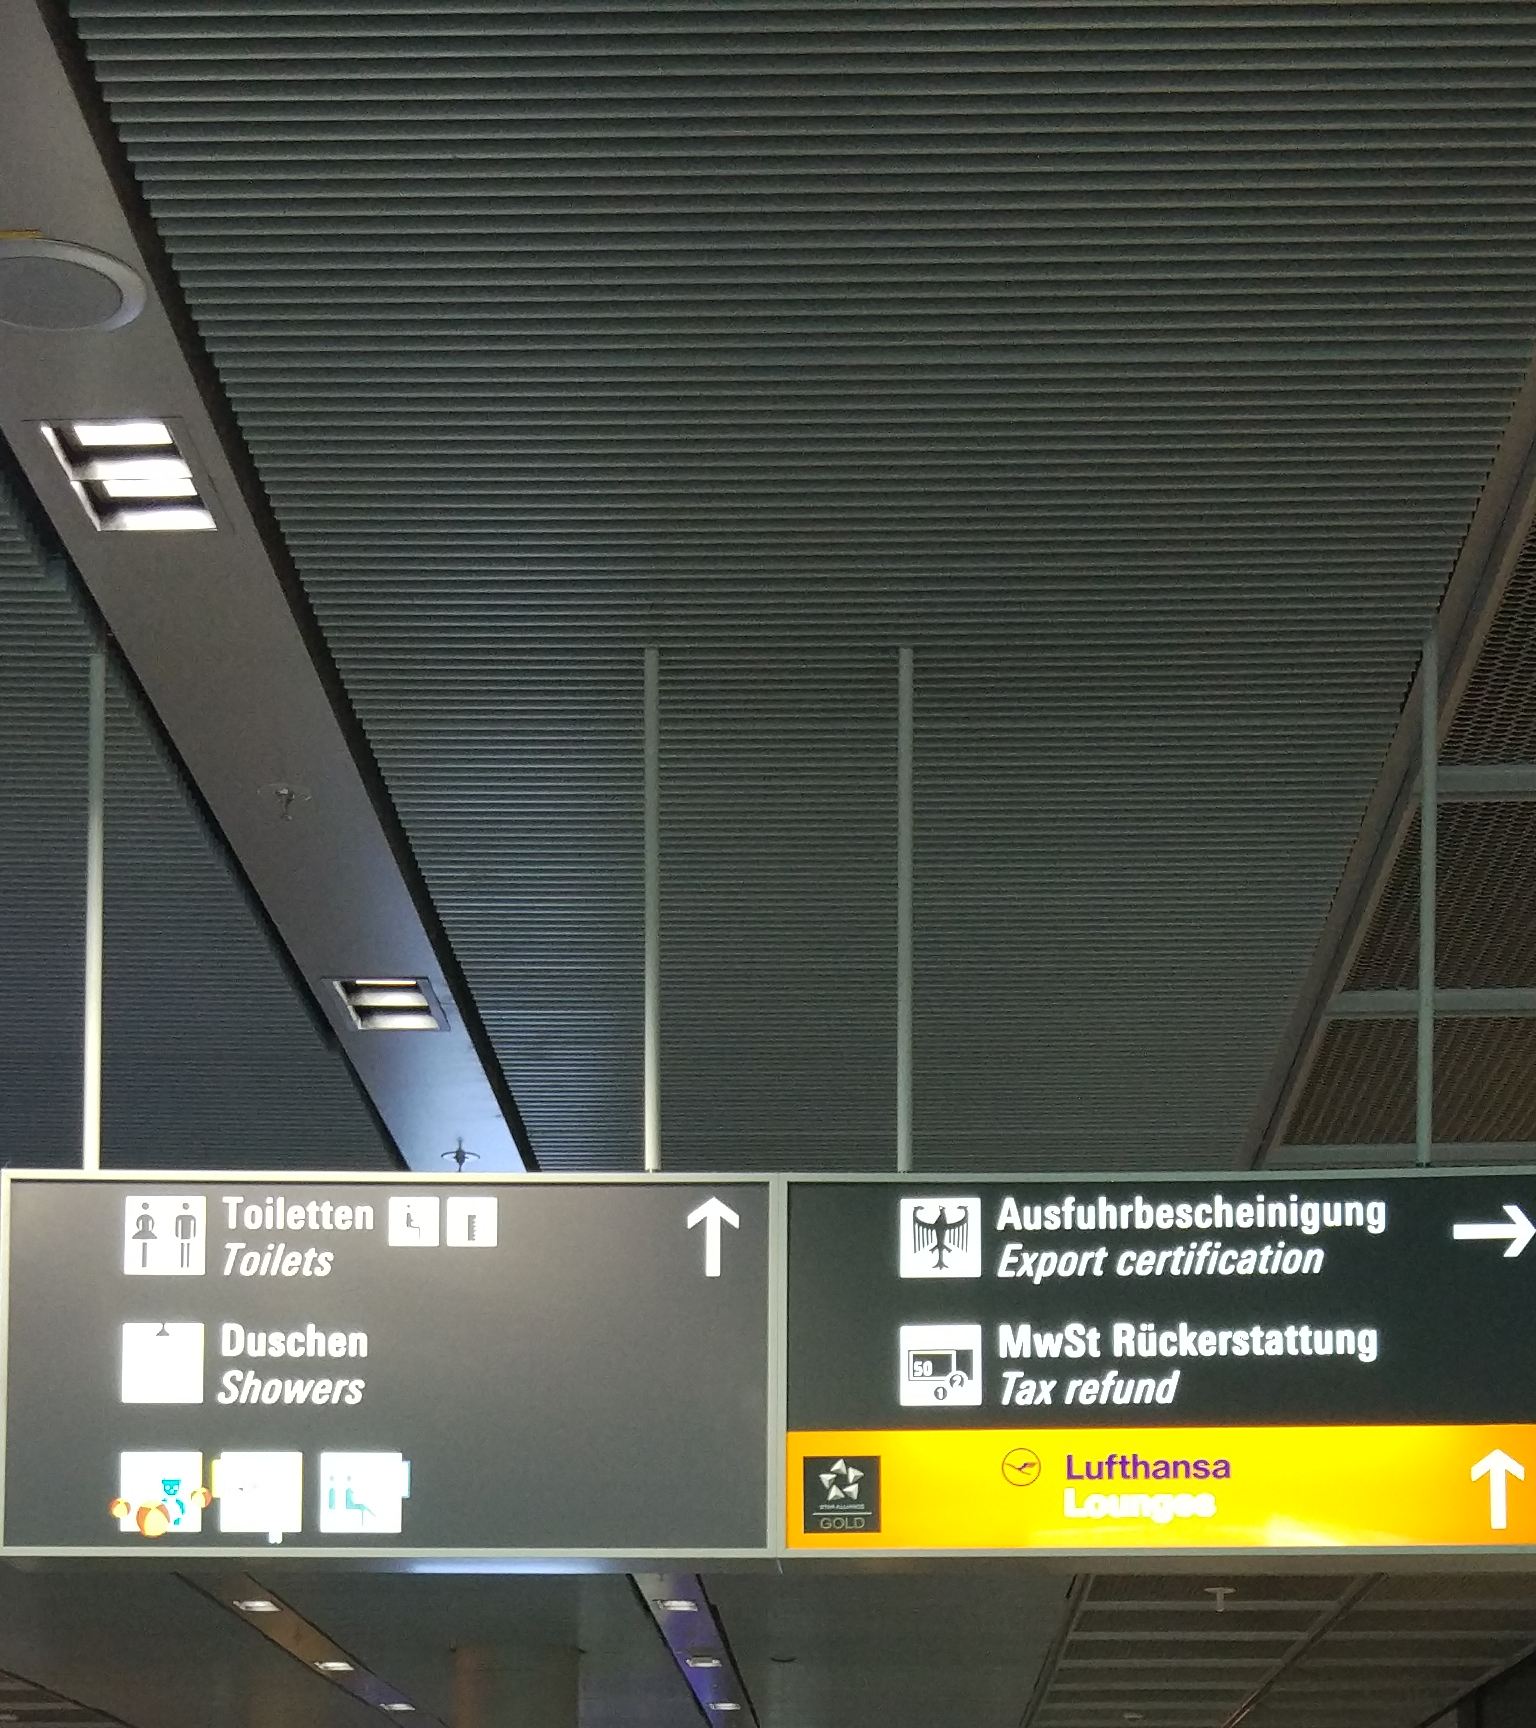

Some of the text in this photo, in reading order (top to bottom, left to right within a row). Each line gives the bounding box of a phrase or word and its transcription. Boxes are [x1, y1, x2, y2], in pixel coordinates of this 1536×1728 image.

[222, 1196, 374, 1231] Toiletten
[997, 1194, 1386, 1234] Ausfuhrbescheinigung
[222, 1243, 334, 1278] Toilets
[998, 1243, 1324, 1281] Export certification
[221, 1323, 368, 1359] Duschen
[998, 1321, 1378, 1362] MwSt Rückerstattung
[217, 1369, 364, 1406] Showers
[1001, 1369, 1180, 1406] Tax refund
[1065, 1453, 1231, 1481] Lufthansa
[1064, 1487, 1216, 1522] Lounges
[820, 1517, 865, 1529] GOLD
